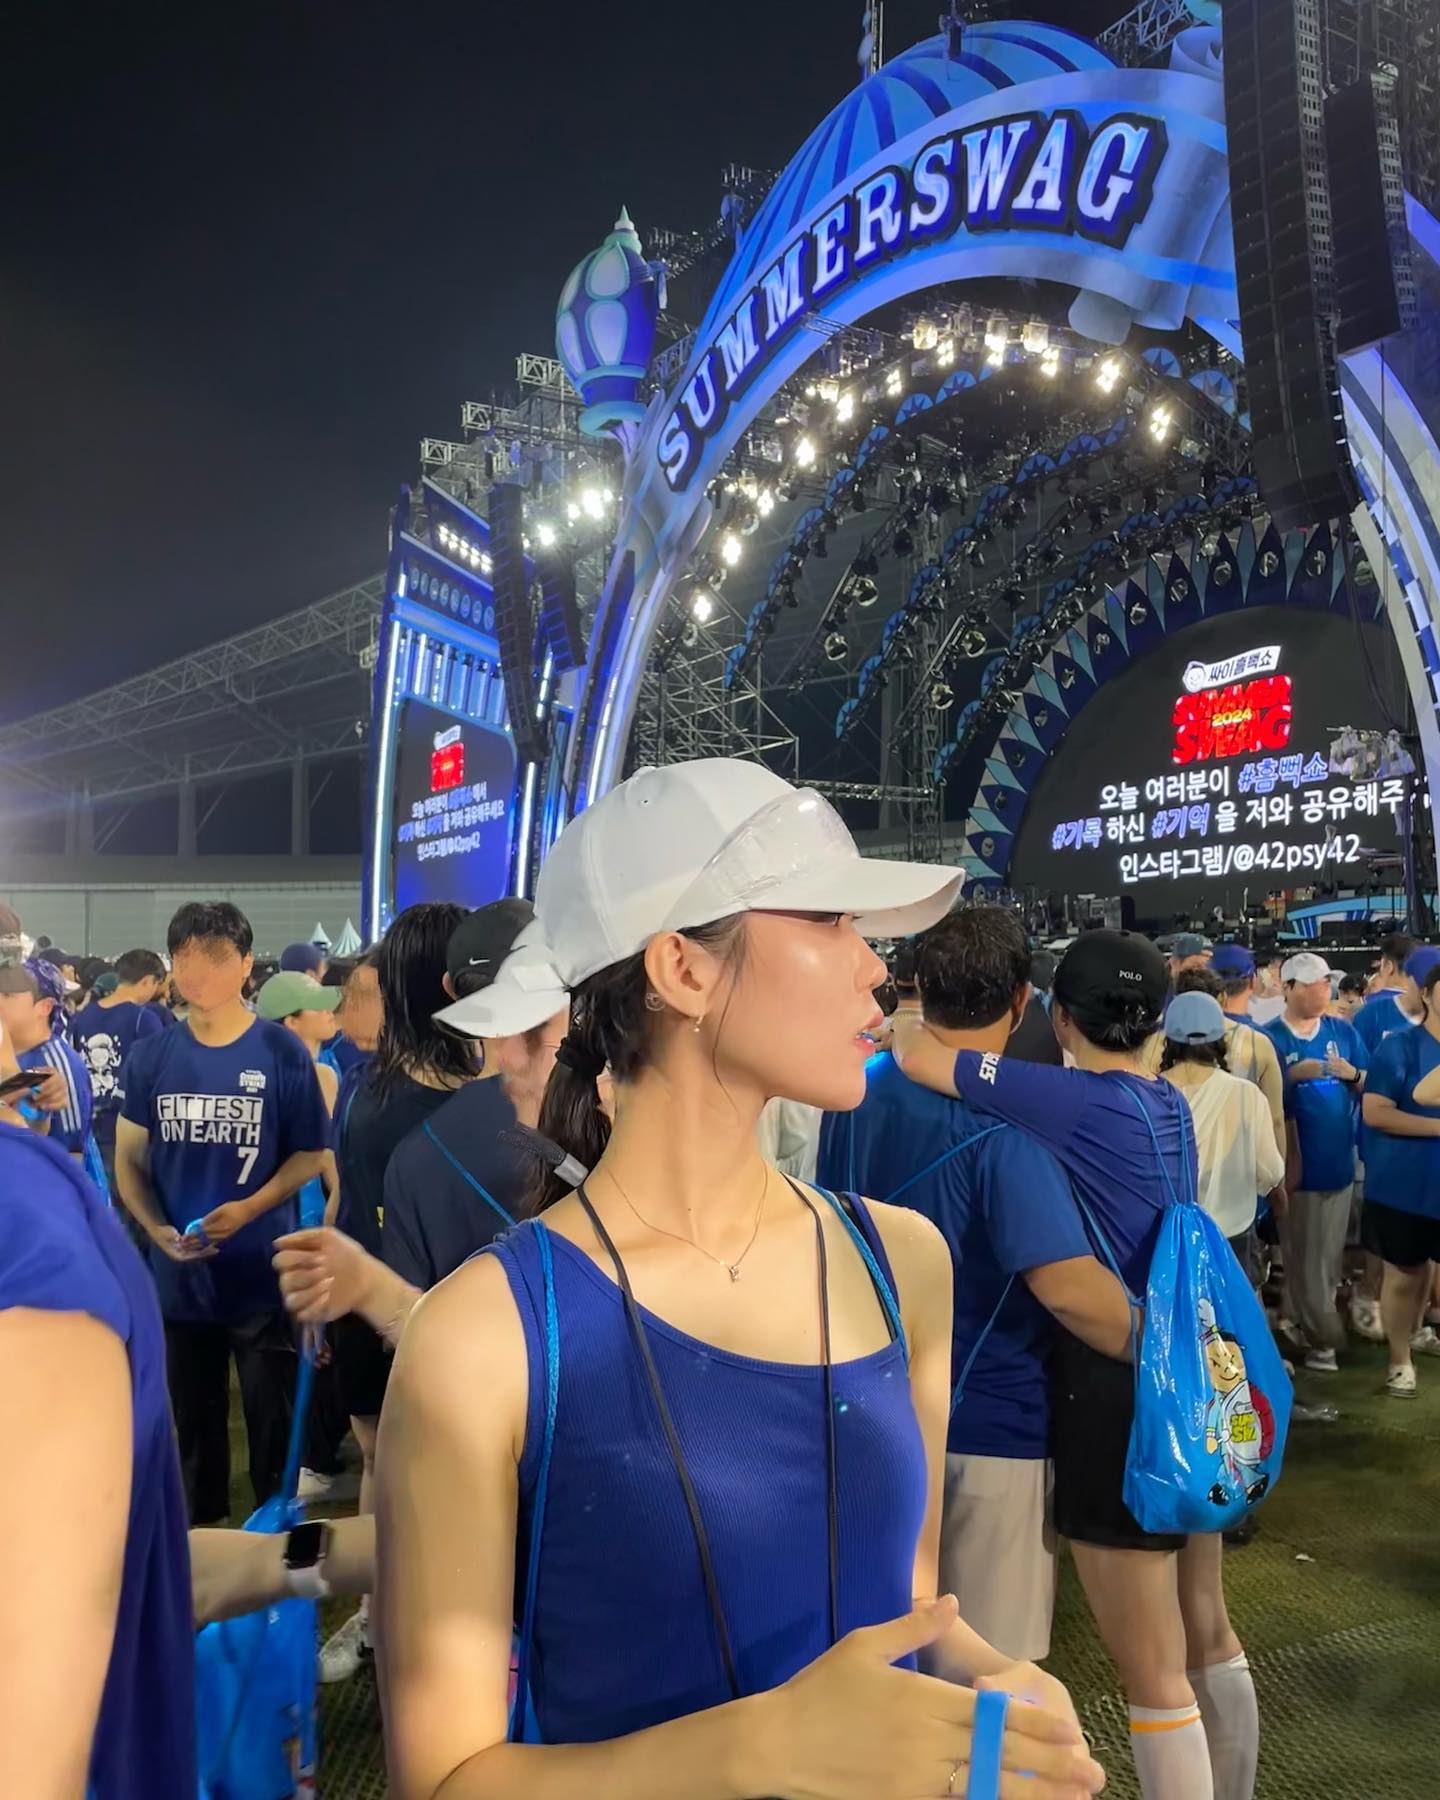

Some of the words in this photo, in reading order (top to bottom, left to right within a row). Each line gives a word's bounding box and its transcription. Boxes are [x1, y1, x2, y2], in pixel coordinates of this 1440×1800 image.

[1212, 707, 1252, 727] 2024
[1099, 781, 1140, 810] 오늘
[1145, 766, 1230, 805] 여러분이
[1052, 817, 1102, 850] #기록
[1106, 812, 1145, 844] 하신
[1151, 803, 1210, 839] #기억
[1214, 801, 1239, 833] 을
[1245, 793, 1294, 829] 저와
[1119, 833, 1361, 883] 인스타그램/@42psy42
[1119, 970, 1142, 981] POLO
[160, 1095, 261, 1121] FITTEST
[160, 1120, 186, 1142] ON
[190, 1120, 261, 1145] EARTH
[237, 1146, 259, 1185] 7
